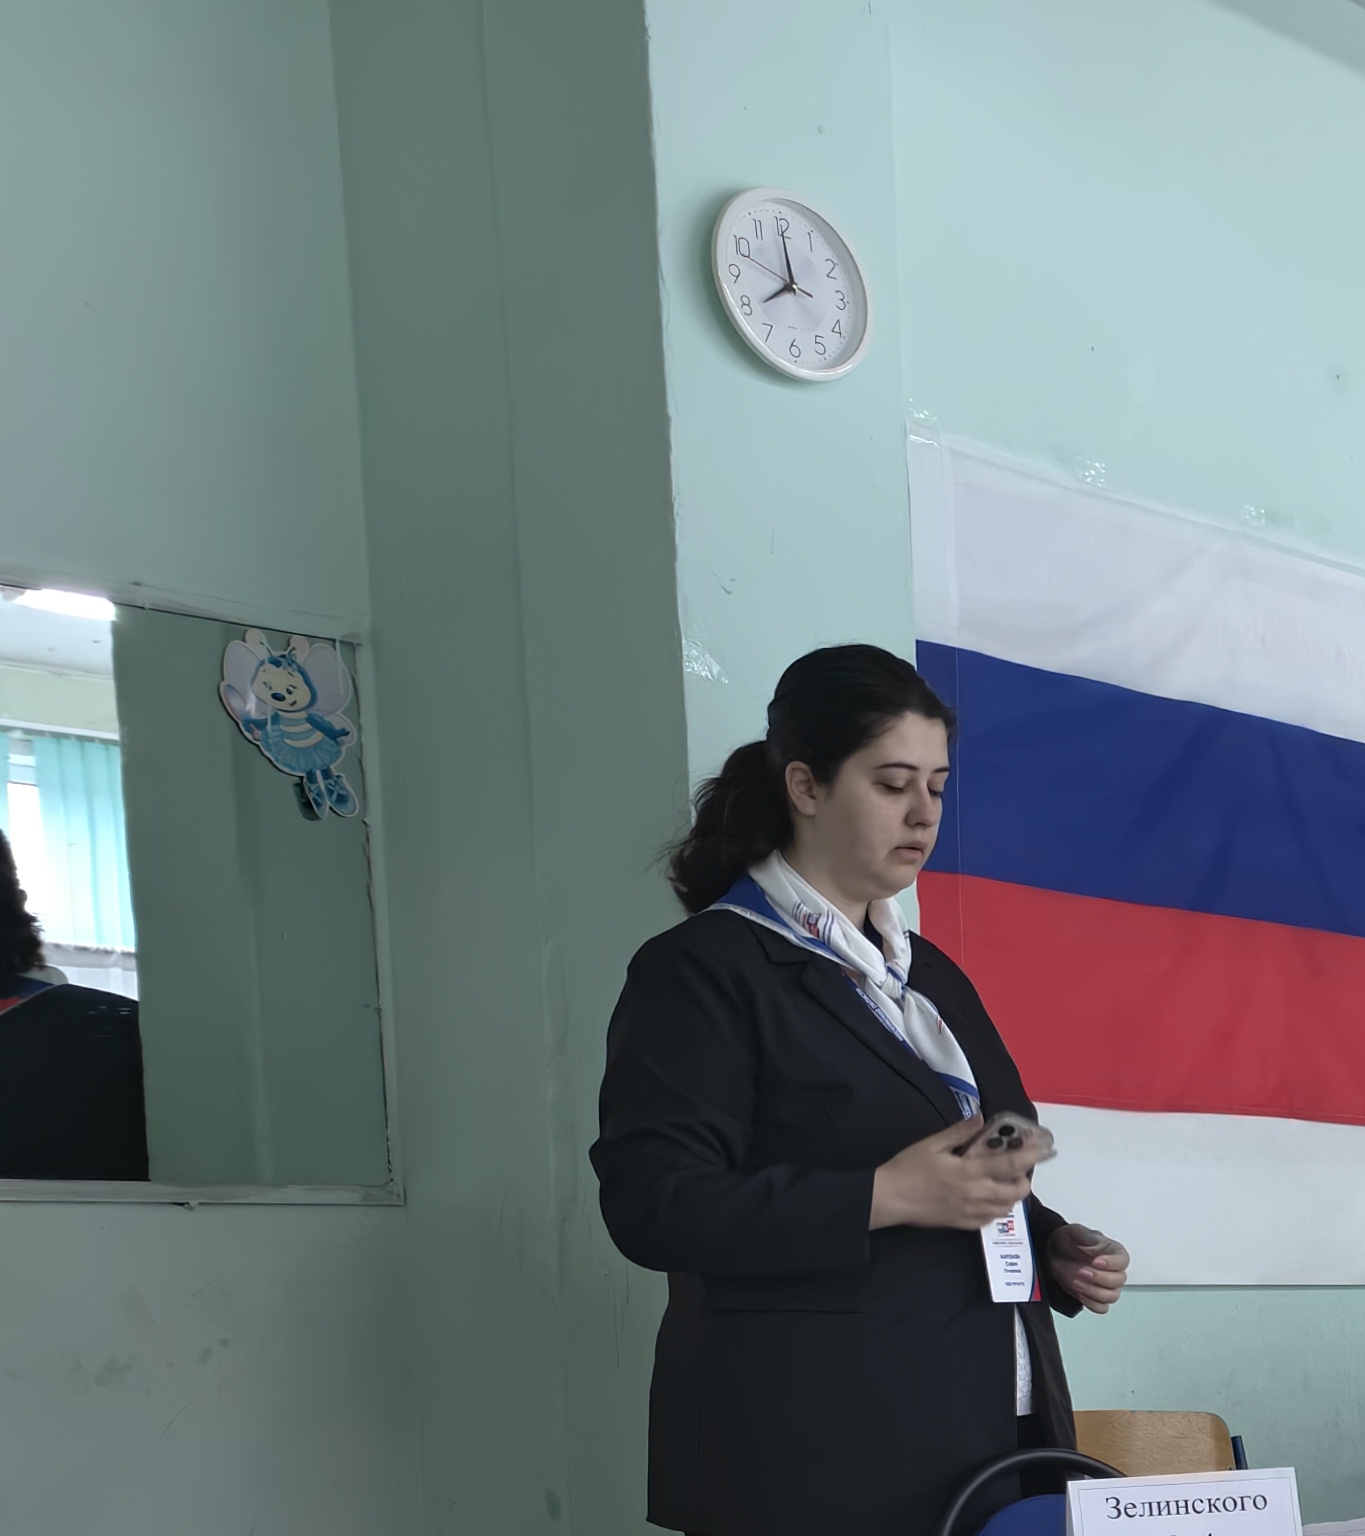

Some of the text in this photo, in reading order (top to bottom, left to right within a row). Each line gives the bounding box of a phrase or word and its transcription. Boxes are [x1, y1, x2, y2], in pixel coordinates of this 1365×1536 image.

[753, 219, 763, 240] 11
[733, 234, 751, 258] 10
[807, 231, 814, 253] 1
[728, 263, 741, 285] 9
[824, 258, 838, 280] 2
[740, 294, 753, 316] 8
[834, 290, 847, 311] 3
[761, 322, 774, 343] 7
[831, 318, 842, 338] 4
[788, 338, 802, 358] 6
[814, 334, 826, 356] 5
[1105, 1492, 1269, 1521] Зелинского
